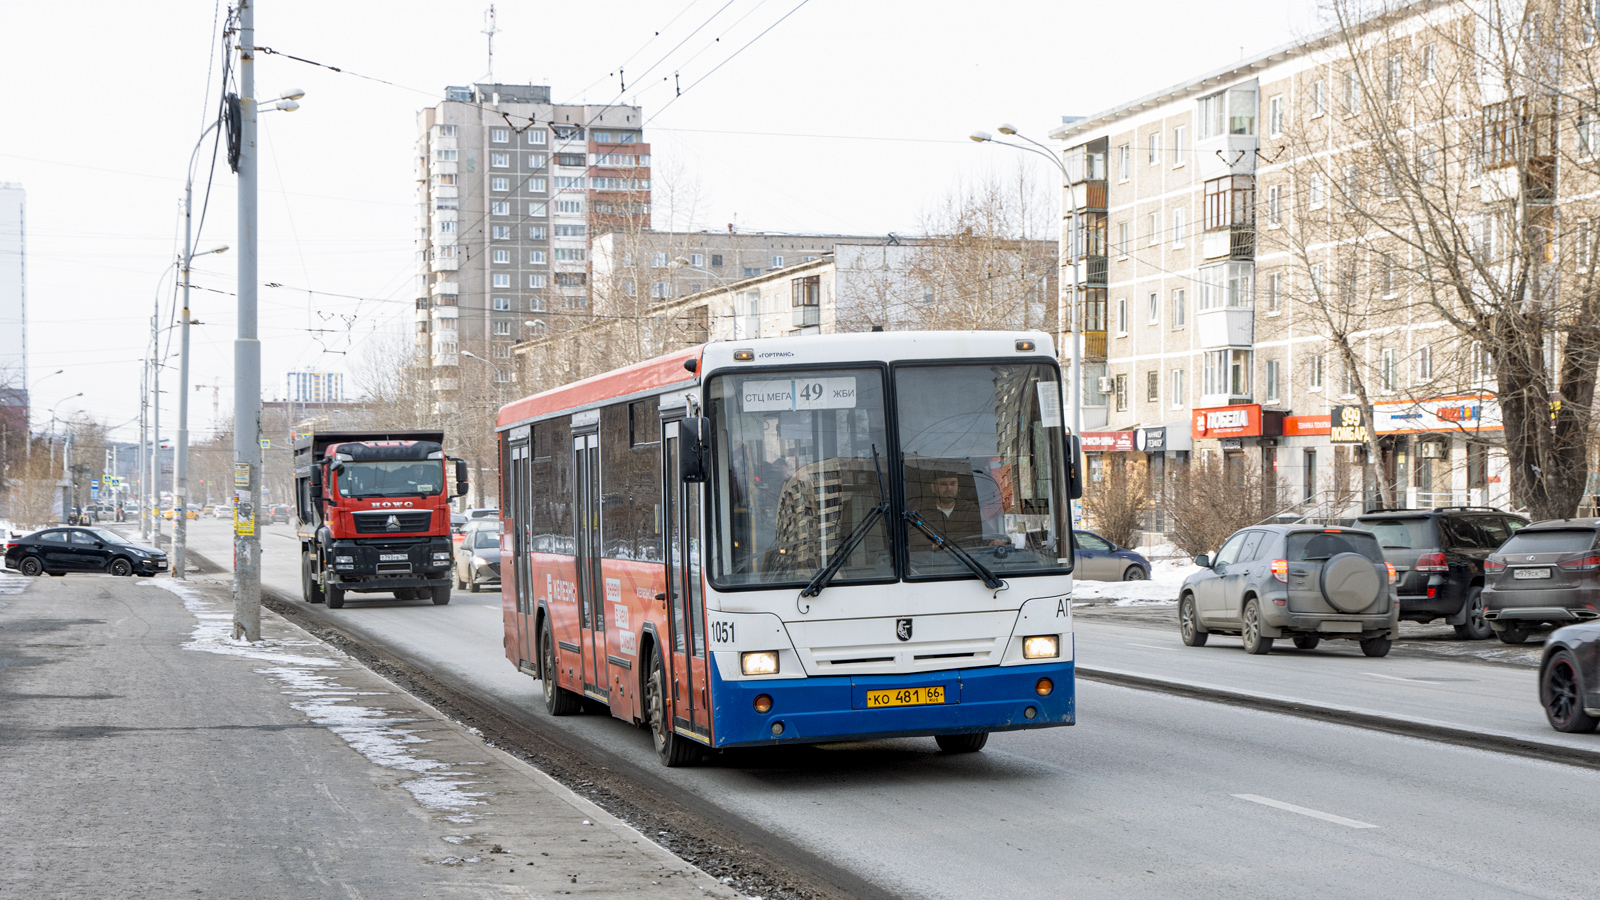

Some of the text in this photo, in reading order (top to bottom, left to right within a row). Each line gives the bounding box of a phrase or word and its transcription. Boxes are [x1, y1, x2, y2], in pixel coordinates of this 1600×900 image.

[745, 392, 792, 403] СТЦ МЕГА
[800, 382, 823, 401] 49
[833, 389, 855, 398] ЖБИ
[1206, 410, 1249, 429] ПОБЕДА
[1341, 406, 1361, 427] 999
[711, 620, 735, 643] 1051
[873, 687, 940, 705] КО 481 66
